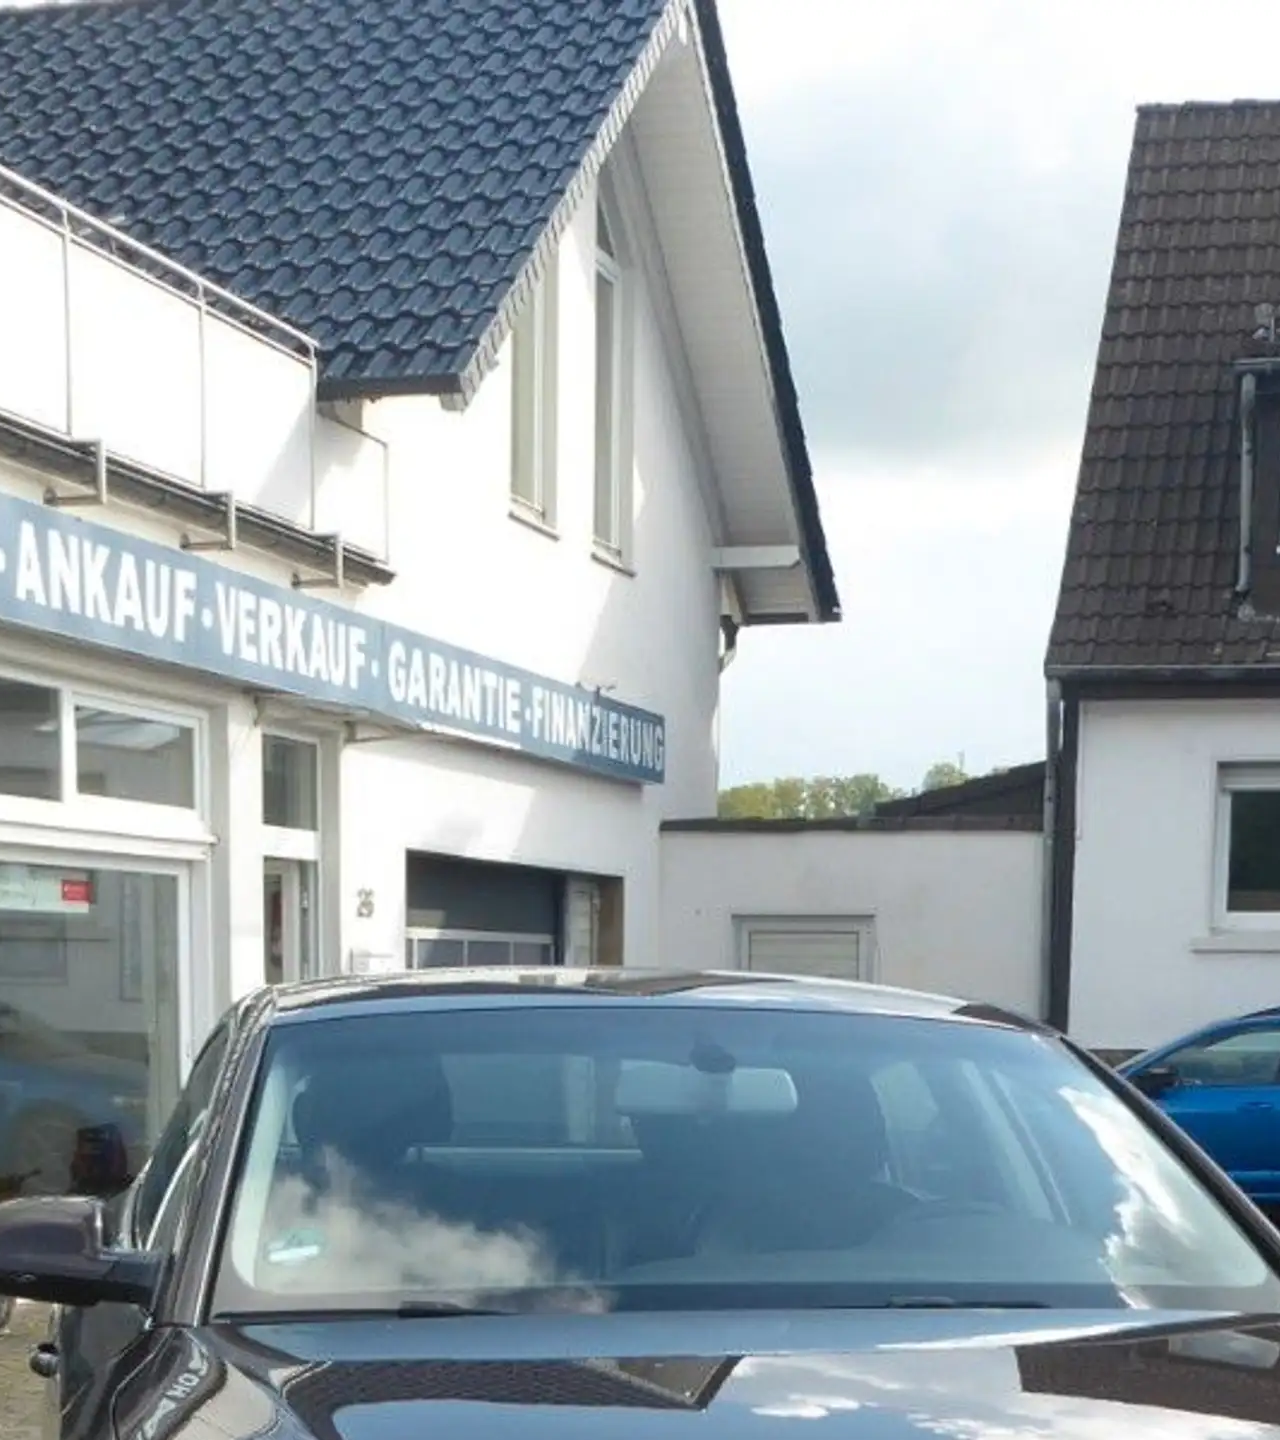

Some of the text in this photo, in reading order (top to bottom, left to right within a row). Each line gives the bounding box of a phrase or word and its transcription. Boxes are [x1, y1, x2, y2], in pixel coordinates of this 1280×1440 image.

[16, 519, 198, 643] ANKAUF
[215, 581, 367, 690] VERKAUF
[388, 640, 521, 734] GARANTIE
[531, 685, 664, 772] FINANZIERUNG
